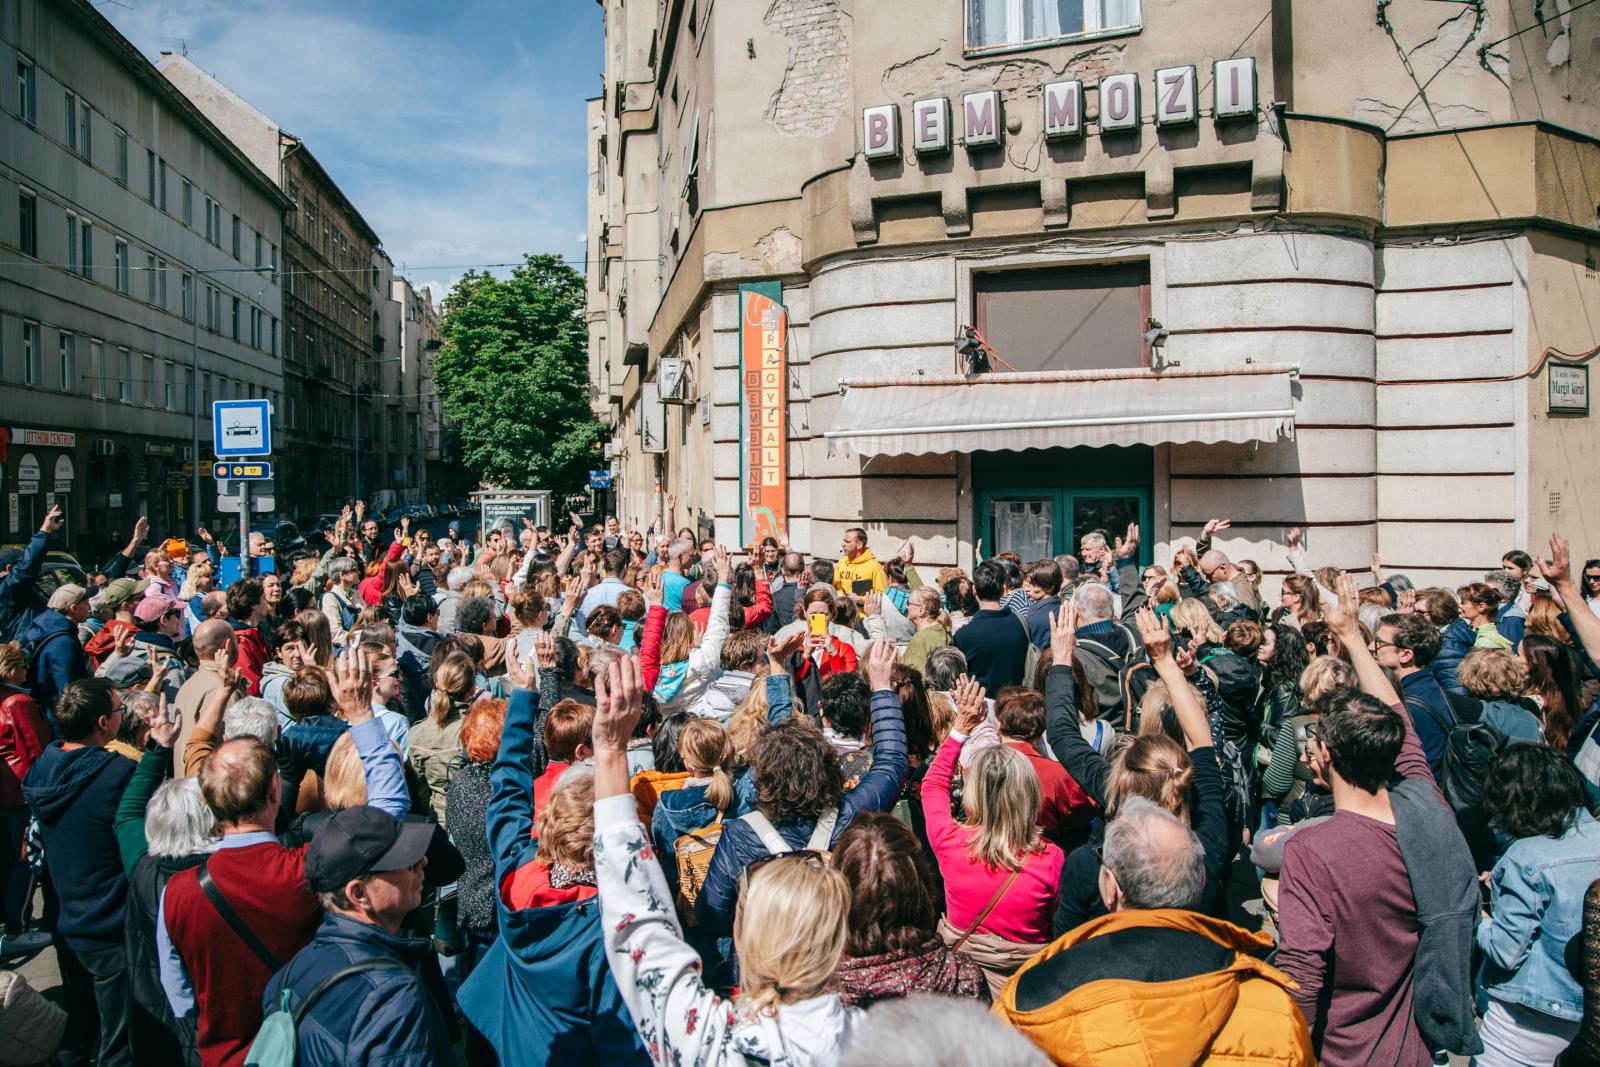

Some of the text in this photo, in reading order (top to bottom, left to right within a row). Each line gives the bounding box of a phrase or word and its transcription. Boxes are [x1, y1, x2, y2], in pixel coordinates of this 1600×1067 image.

[868, 66, 1240, 150] BEM MOZI
[766, 333, 777, 482] FAGYLALT
